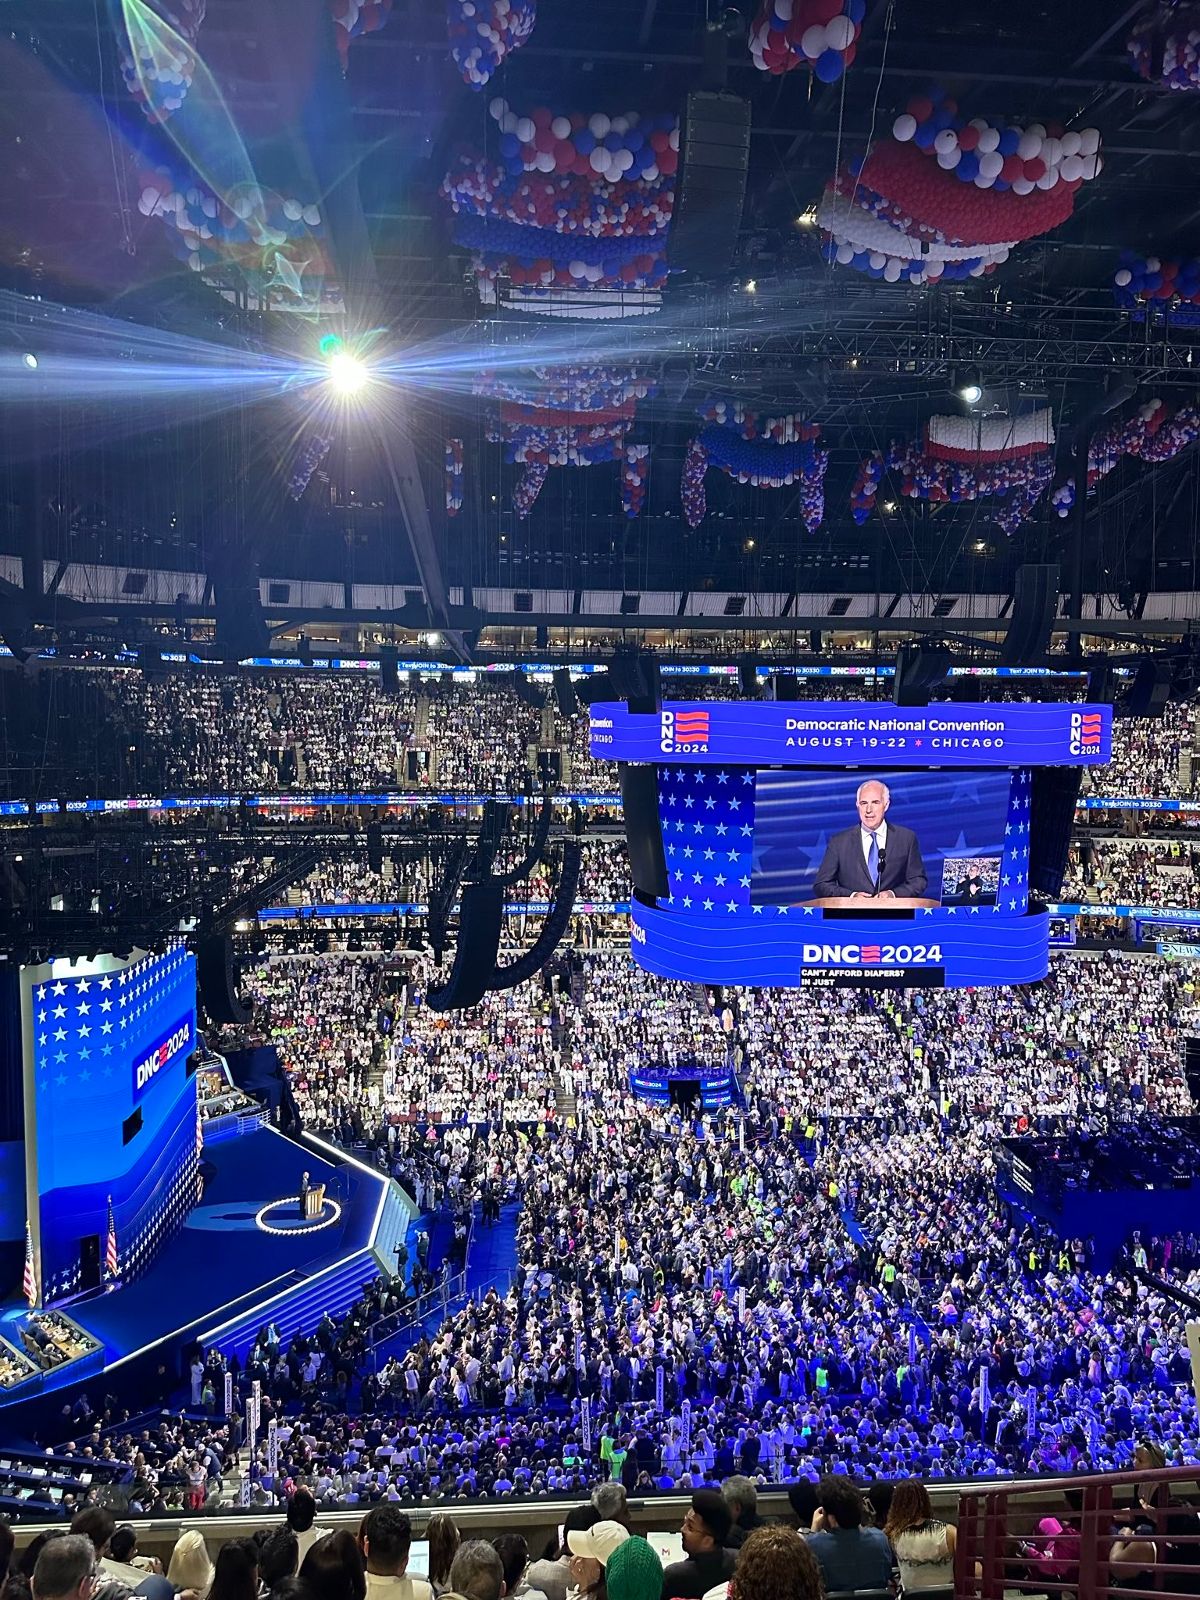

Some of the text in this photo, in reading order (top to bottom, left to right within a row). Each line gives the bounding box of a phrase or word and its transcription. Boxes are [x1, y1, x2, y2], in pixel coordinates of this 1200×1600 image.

[786, 718, 1005, 732] Democratic National Convention
[785, 737, 1004, 748] AUGUST 19-22 CHICAGO
[674, 743, 709, 753] 2024
[1080, 745, 1100, 755] 2024
[104, 799, 163, 810] DNC 2024
[592, 903, 616, 913] 2024
[1079, 905, 1117, 916] C-SPAN
[1159, 908, 1184, 918] NEWS
[802, 944, 943, 963] DNC 2024
[801, 968, 906, 978] CAN'T AFFORD DIAPERS?
[801, 978, 836, 986] IN JUST
[136, 1022, 190, 1090] DNC 2024
